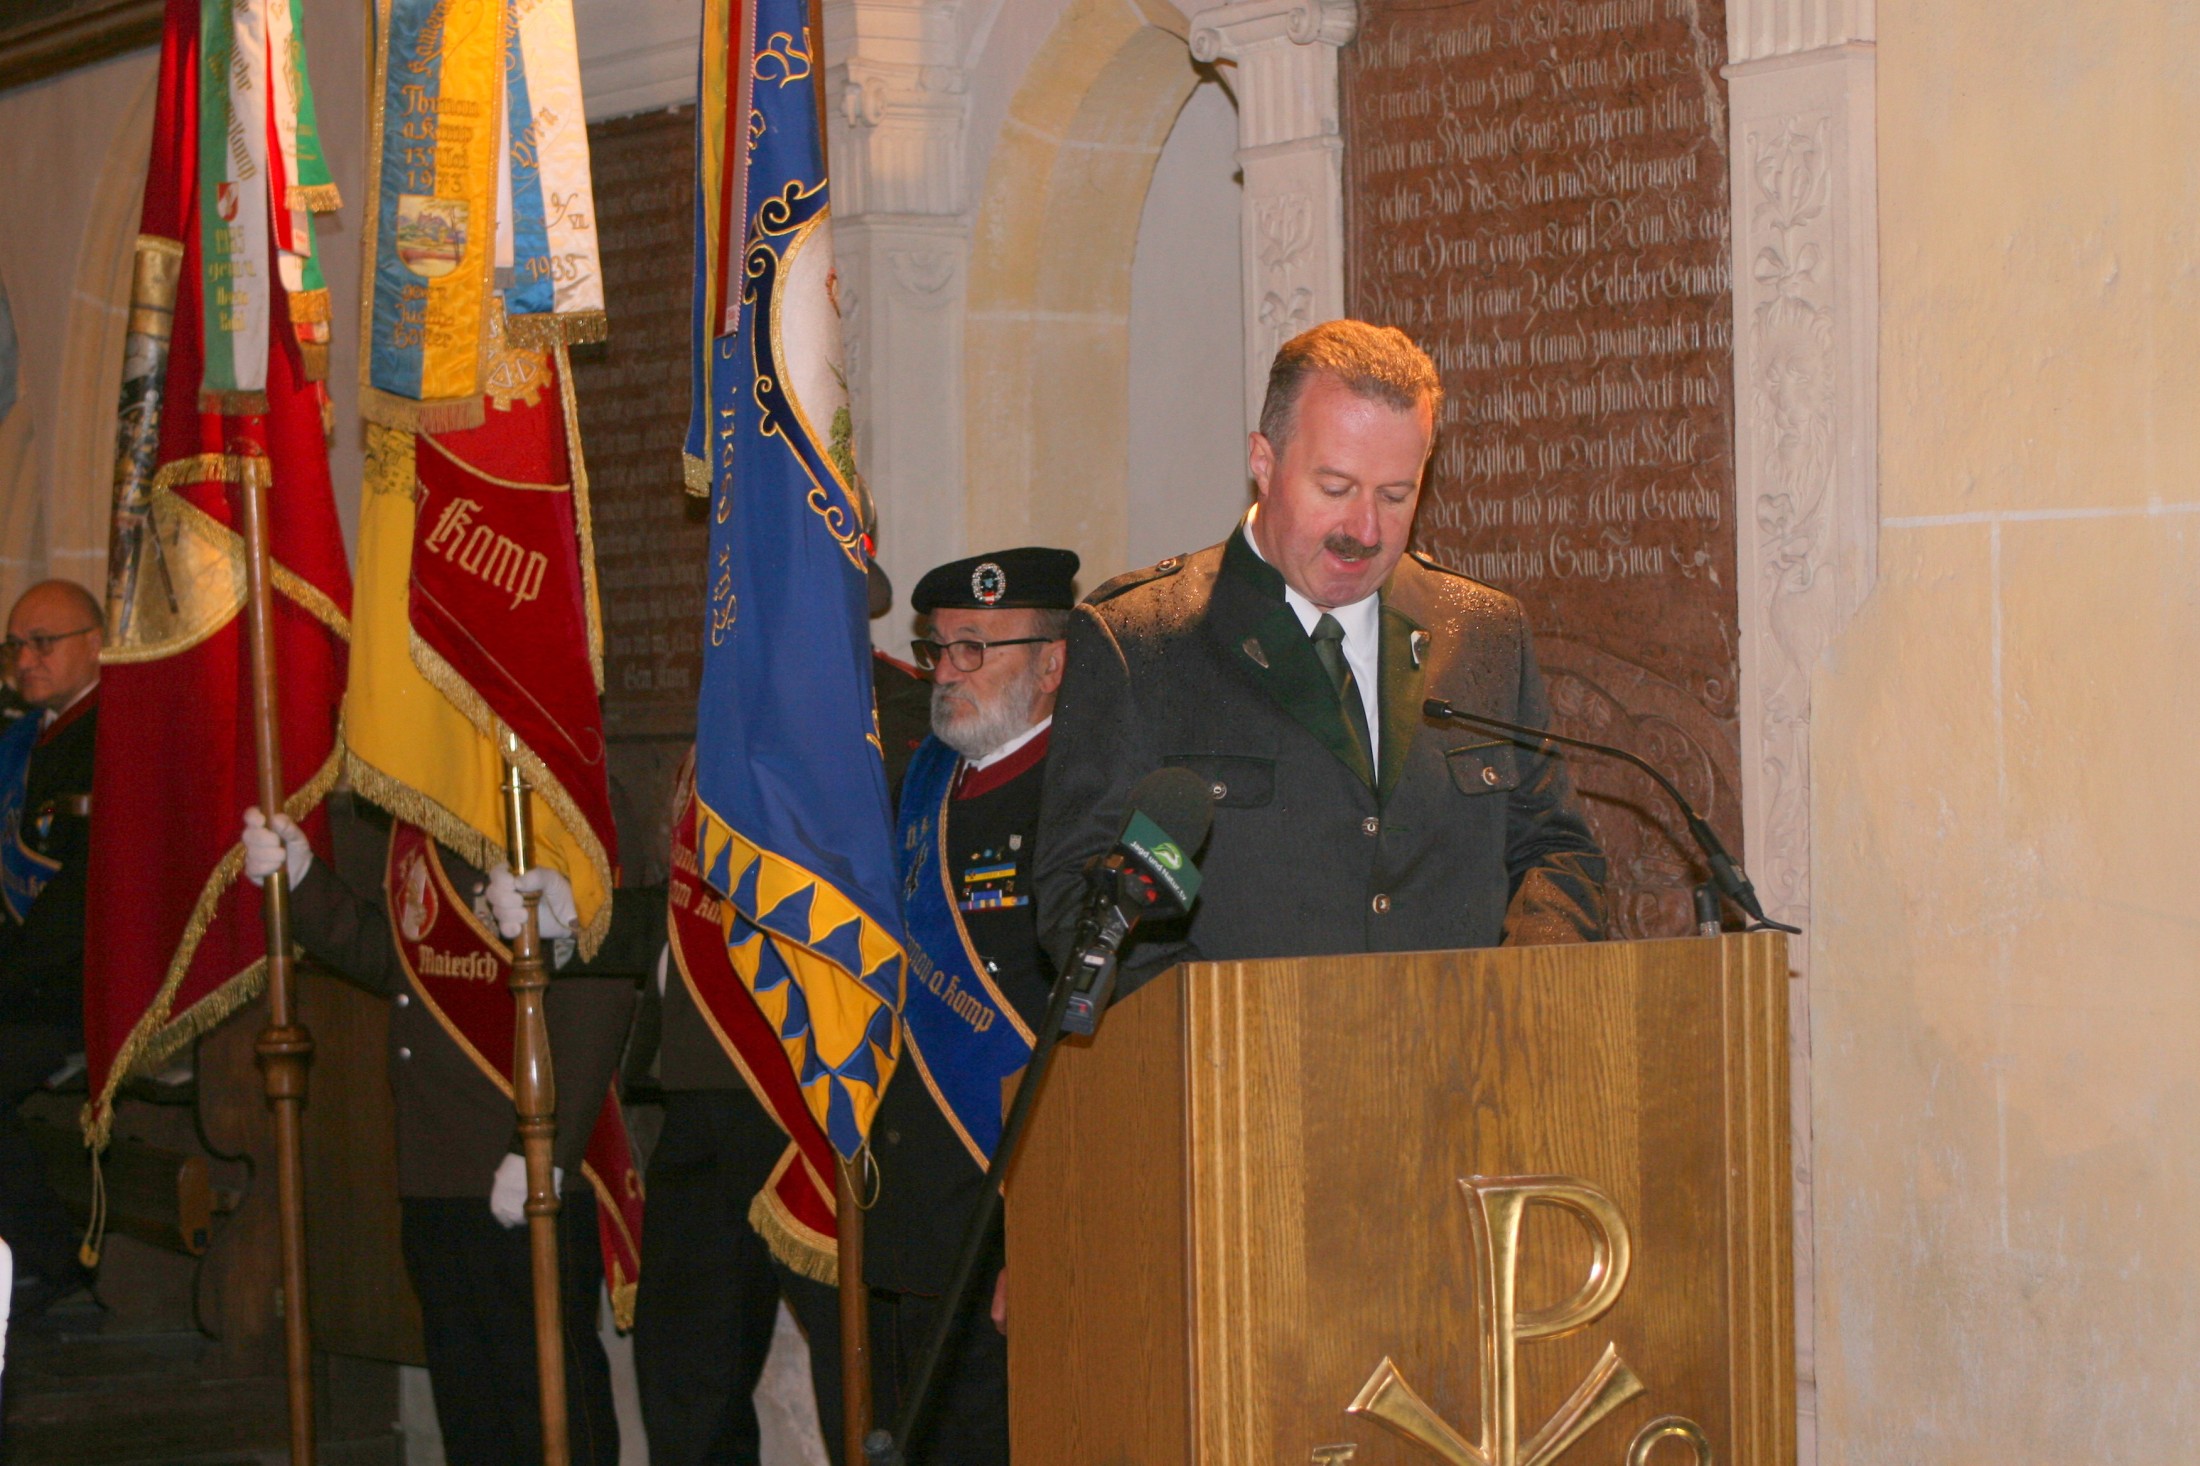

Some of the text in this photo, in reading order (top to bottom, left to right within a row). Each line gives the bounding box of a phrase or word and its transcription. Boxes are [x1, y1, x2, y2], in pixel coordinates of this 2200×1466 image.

[425, 497, 549, 611] Kamp
[418, 944, 499, 984] Maiersch
[941, 975, 996, 1033] Kamp
